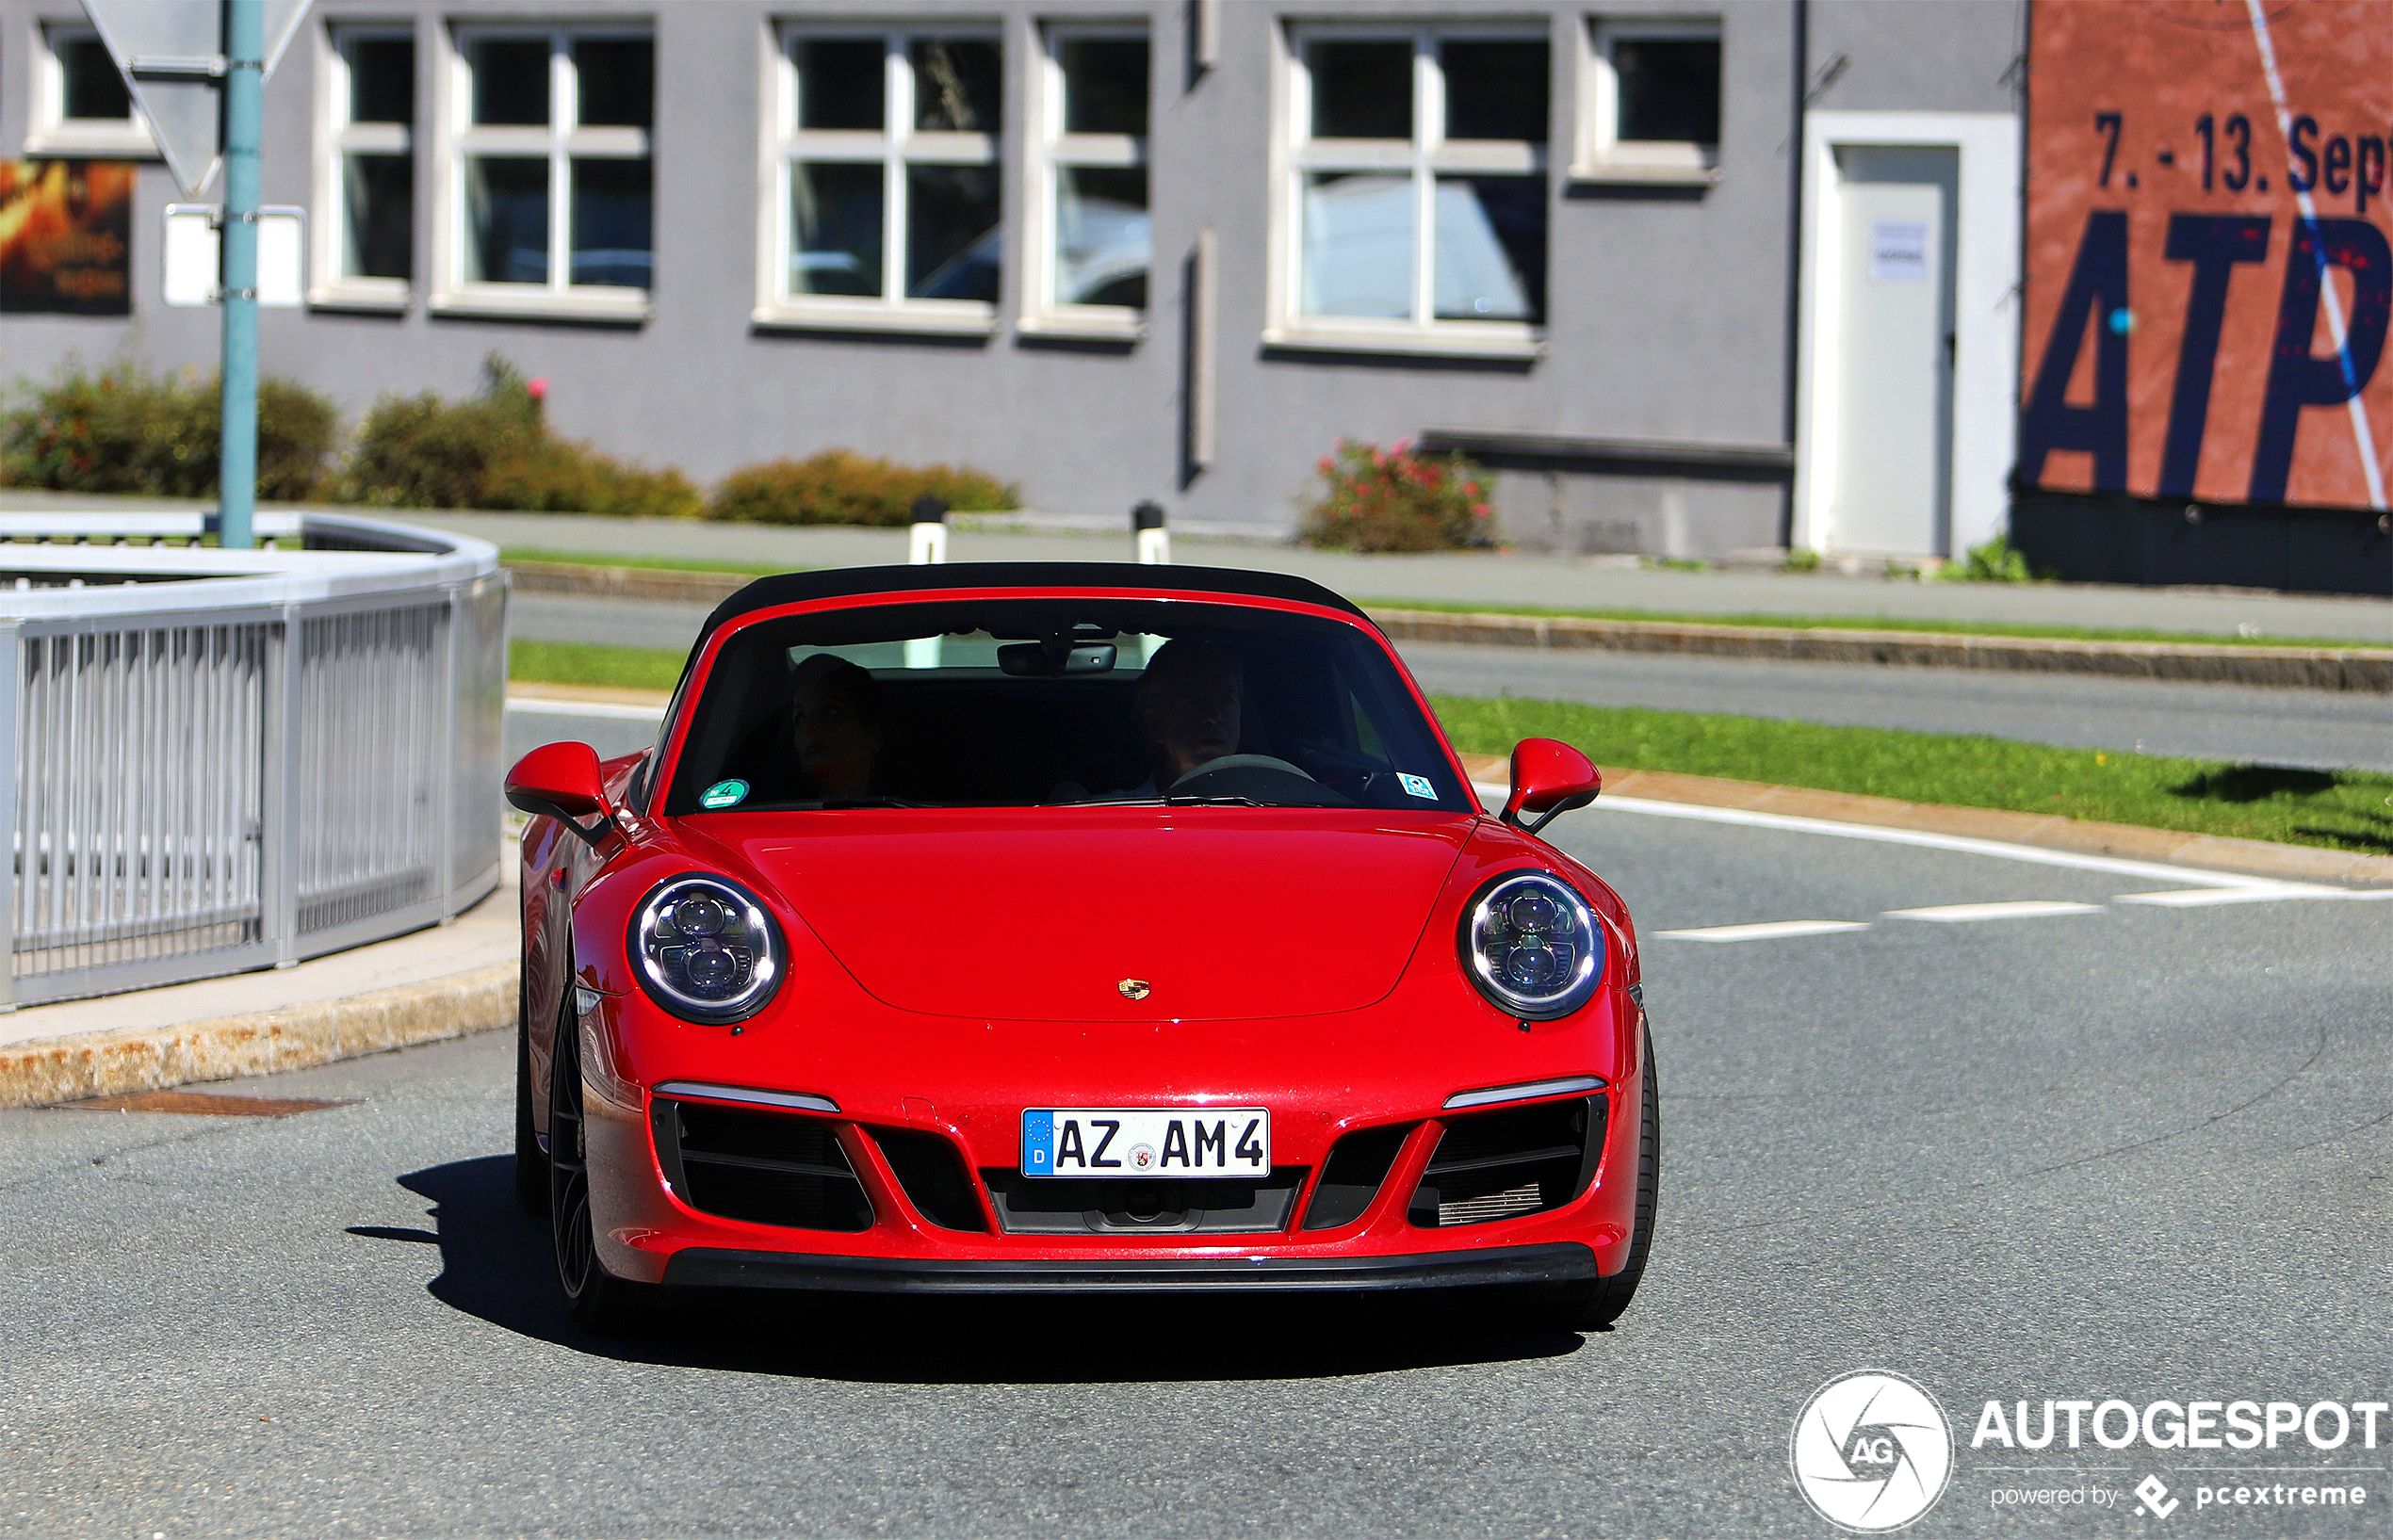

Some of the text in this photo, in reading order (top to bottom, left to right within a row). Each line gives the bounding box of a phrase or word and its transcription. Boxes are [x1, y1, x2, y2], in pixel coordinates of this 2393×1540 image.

[2095, 111, 2139, 188] 7.
[2195, 111, 2268, 192] 13.
[2288, 113, 2393, 213] Sep
[2018, 209, 2393, 503] ATP
[1034, 1149, 1045, 1164] D
[1056, 1120, 1121, 1167] AZ
